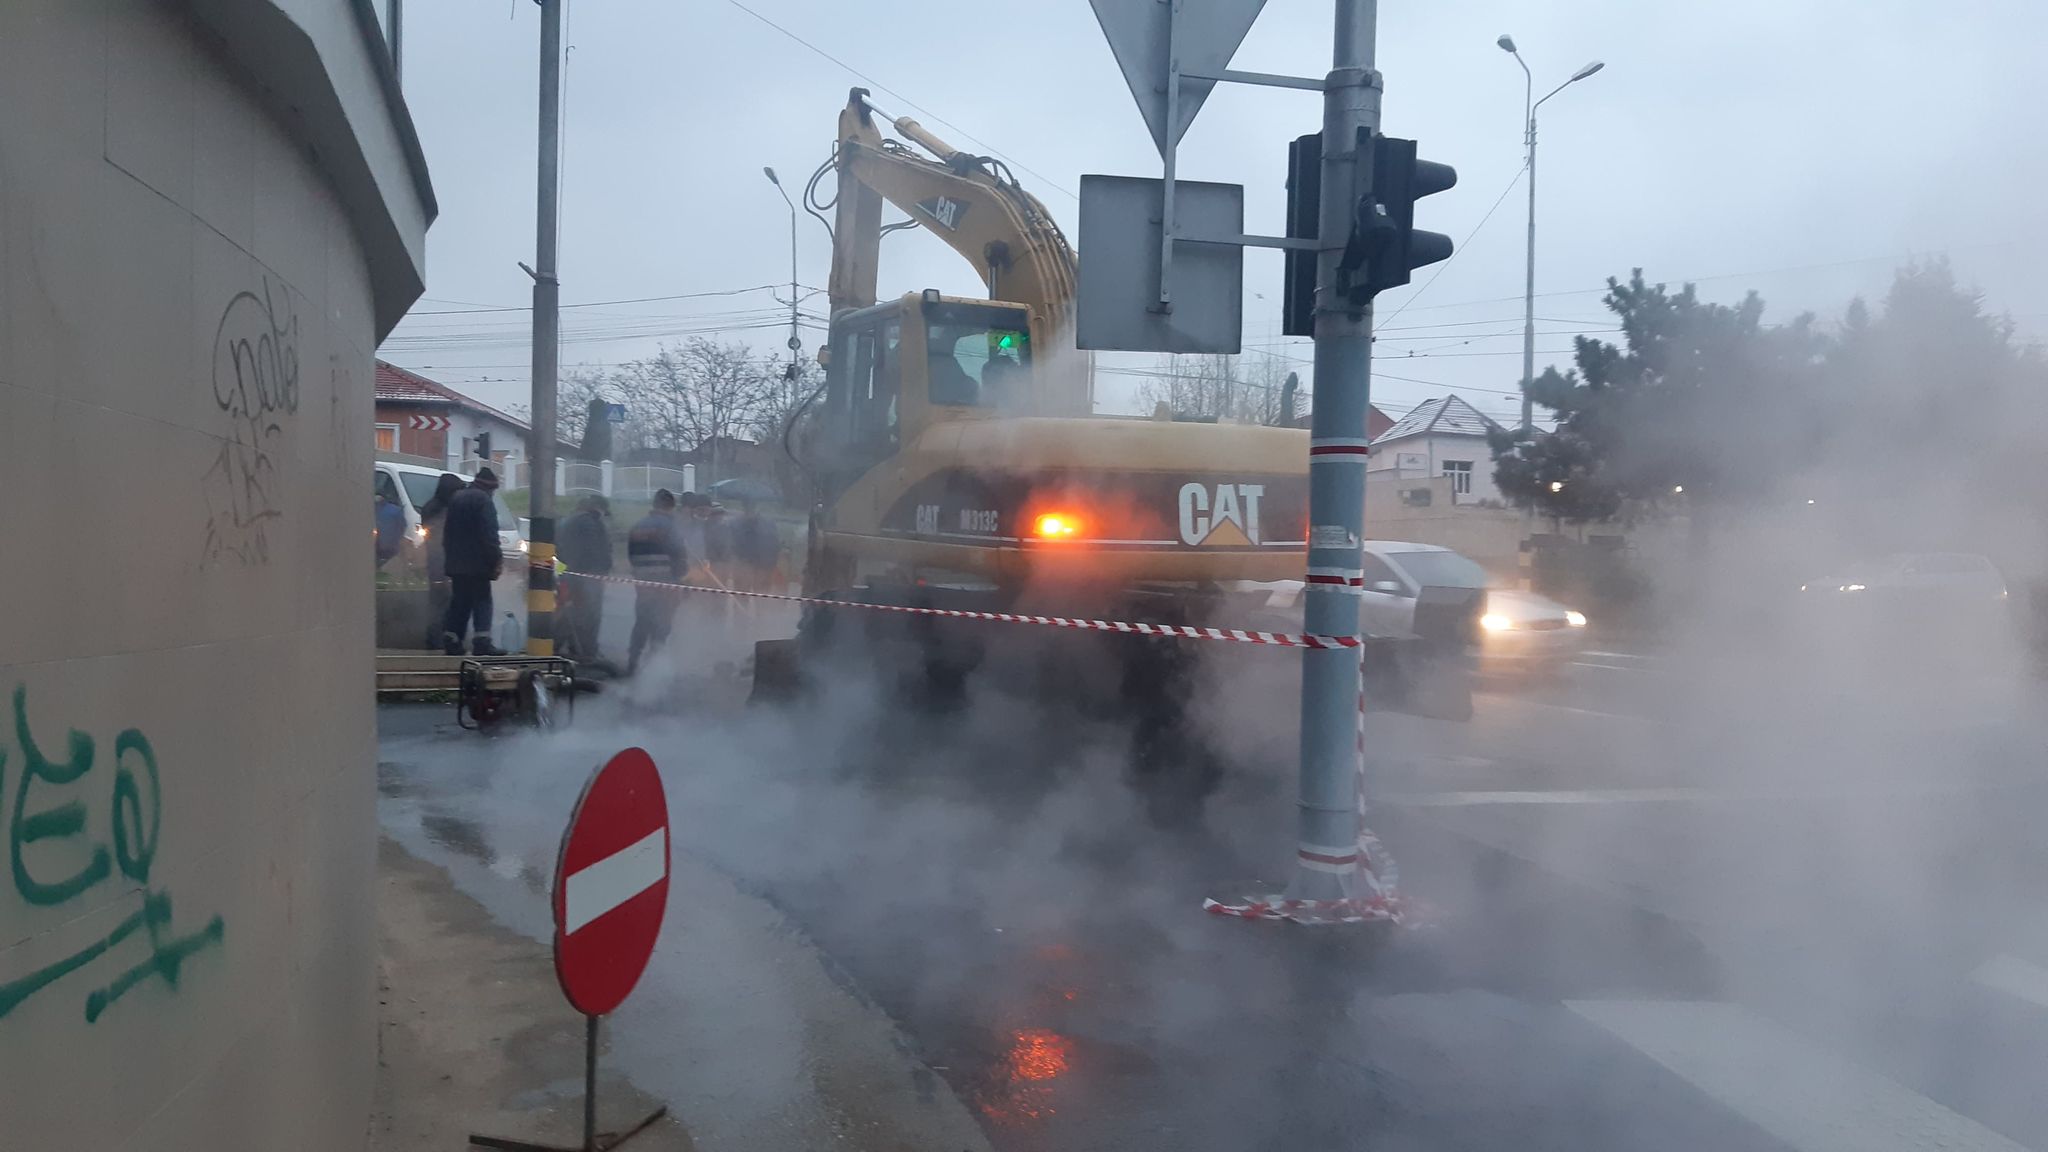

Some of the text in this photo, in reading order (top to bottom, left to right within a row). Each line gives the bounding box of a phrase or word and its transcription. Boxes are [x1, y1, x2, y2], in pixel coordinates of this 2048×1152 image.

[936, 196, 957, 228] CAT
[916, 504, 940, 535] CAT
[1178, 482, 1265, 546] CAT
